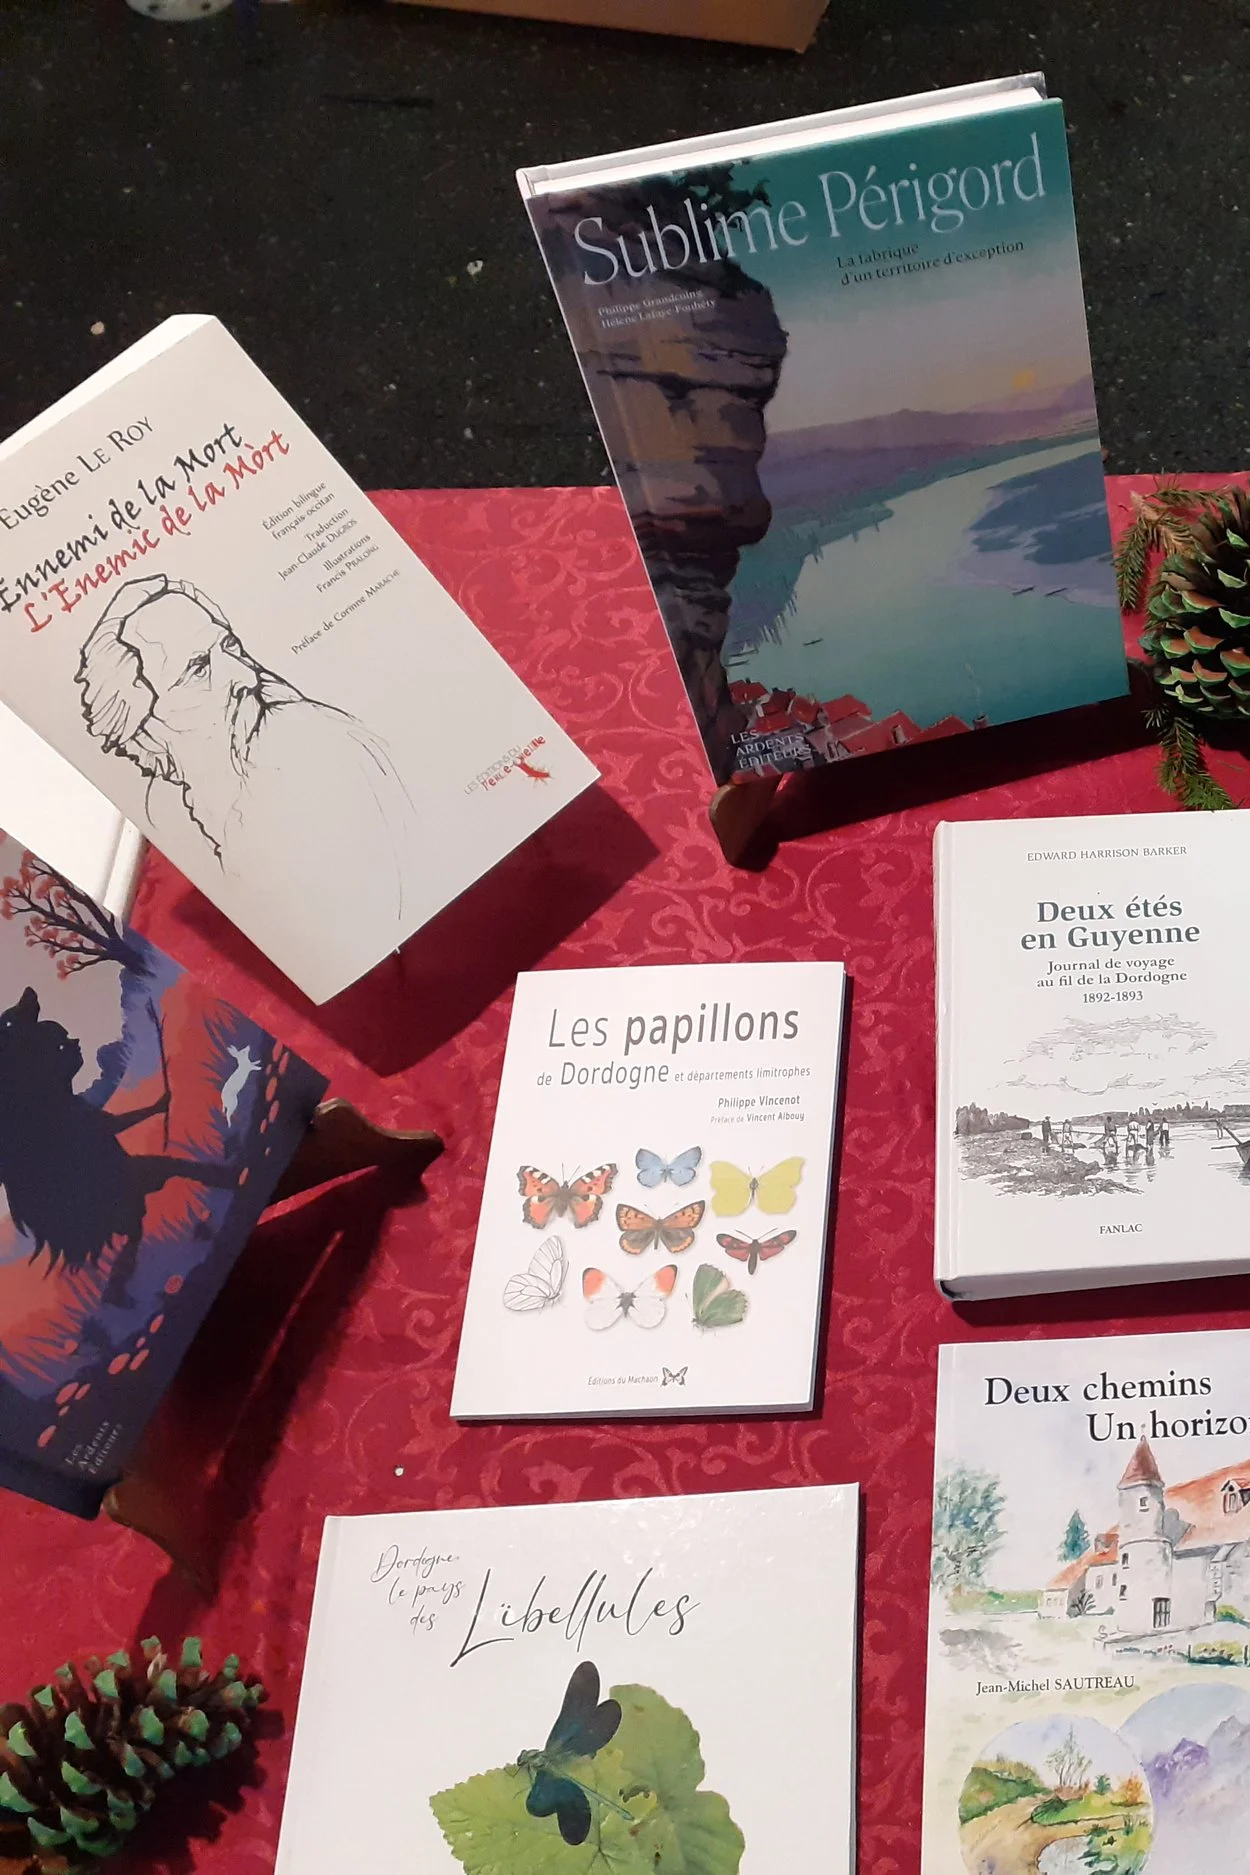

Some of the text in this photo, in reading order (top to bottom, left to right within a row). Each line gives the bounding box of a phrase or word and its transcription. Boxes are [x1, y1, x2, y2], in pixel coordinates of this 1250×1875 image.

[574, 132, 1047, 286] Sublime Périgord
[837, 243, 919, 269] La fabrique
[840, 241, 1025, 286] d'un territoire d'exception
[598, 302, 640, 316] Philippe
[0, 416, 154, 530] Eugène LE ROY
[109, 498, 142, 531] de
[137, 479, 176, 505] la
[173, 423, 242, 483] Mort
[262, 482, 327, 531] Édition bilingue
[24, 429, 290, 633] L'Enemic de la Mòrt
[305, 508, 349, 542] Traduction
[278, 540, 327, 581] Jean-Claude
[322, 534, 371, 571] Illustrations
[316, 570, 347, 593] Francis
[291, 631, 322, 655] Préface
[323, 620, 335, 632] de
[333, 596, 366, 622] Corinne
[731, 729, 760, 745] LES
[736, 733, 805, 757] ARDENTS
[739, 743, 812, 769] ÉDITEURS
[1027, 846, 1187, 862] EDWARD HARRISON BARKER
[1036, 894, 1184, 923] Deux étés
[1020, 926, 1201, 952] en Guyenne
[1036, 971, 1188, 988] au fil de la Dordogne
[1047, 956, 1176, 976] Journal de voyage
[1082, 990, 1144, 1004] 1892-1893
[548, 1002, 799, 1056] Les papillons
[536, 1061, 811, 1090] de Dordogne et départements limitrophes
[717, 1094, 801, 1111] Philippe Vincenot
[736, 1114, 745, 1124] de
[746, 1112, 776, 1123] Vincent
[777, 1111, 805, 1124] Albouy
[1099, 1222, 1143, 1235] FANLAC
[617, 1376, 626, 1385] du
[627, 1375, 659, 1384] Machaon
[984, 1370, 1212, 1406] Deux chemins
[1086, 1412, 1136, 1442] Un
[411, 1579, 464, 1608] pays
[410, 1605, 438, 1635] des
[449, 1567, 701, 1668] Libellules
[975, 1675, 1135, 1696] Jean-Michel SAUTREAU
